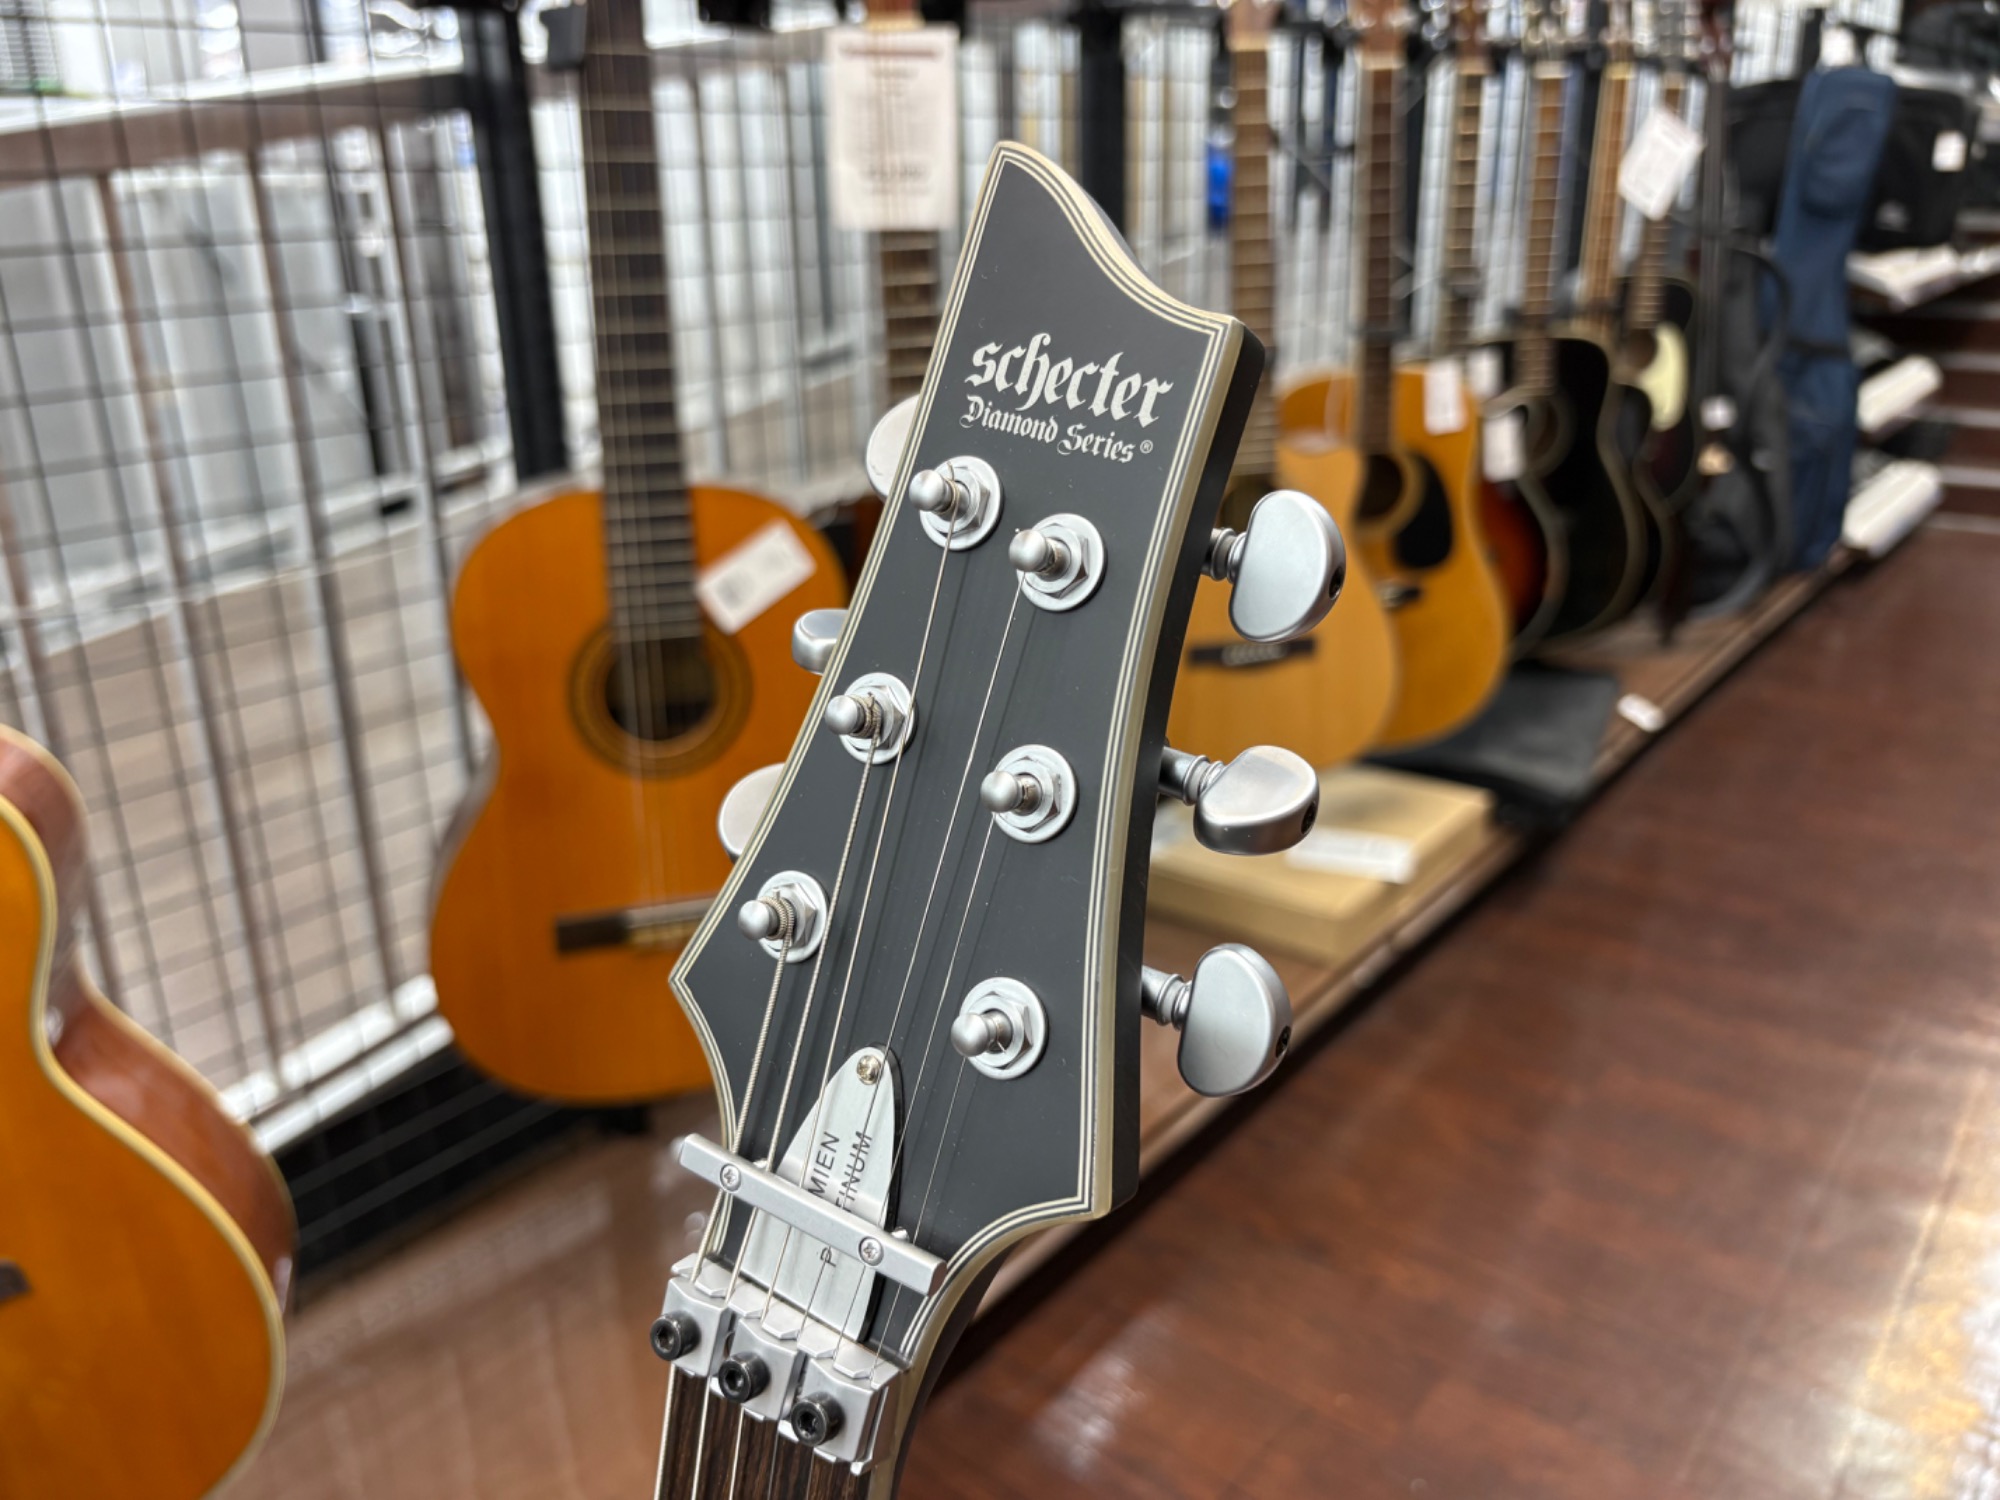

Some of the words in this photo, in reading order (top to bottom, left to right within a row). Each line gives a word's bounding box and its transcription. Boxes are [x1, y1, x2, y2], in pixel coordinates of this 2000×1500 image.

[964, 332, 1174, 428] schecter
[959, 393, 1059, 443] Diamond
[807, 1131, 840, 1199] MIEN
